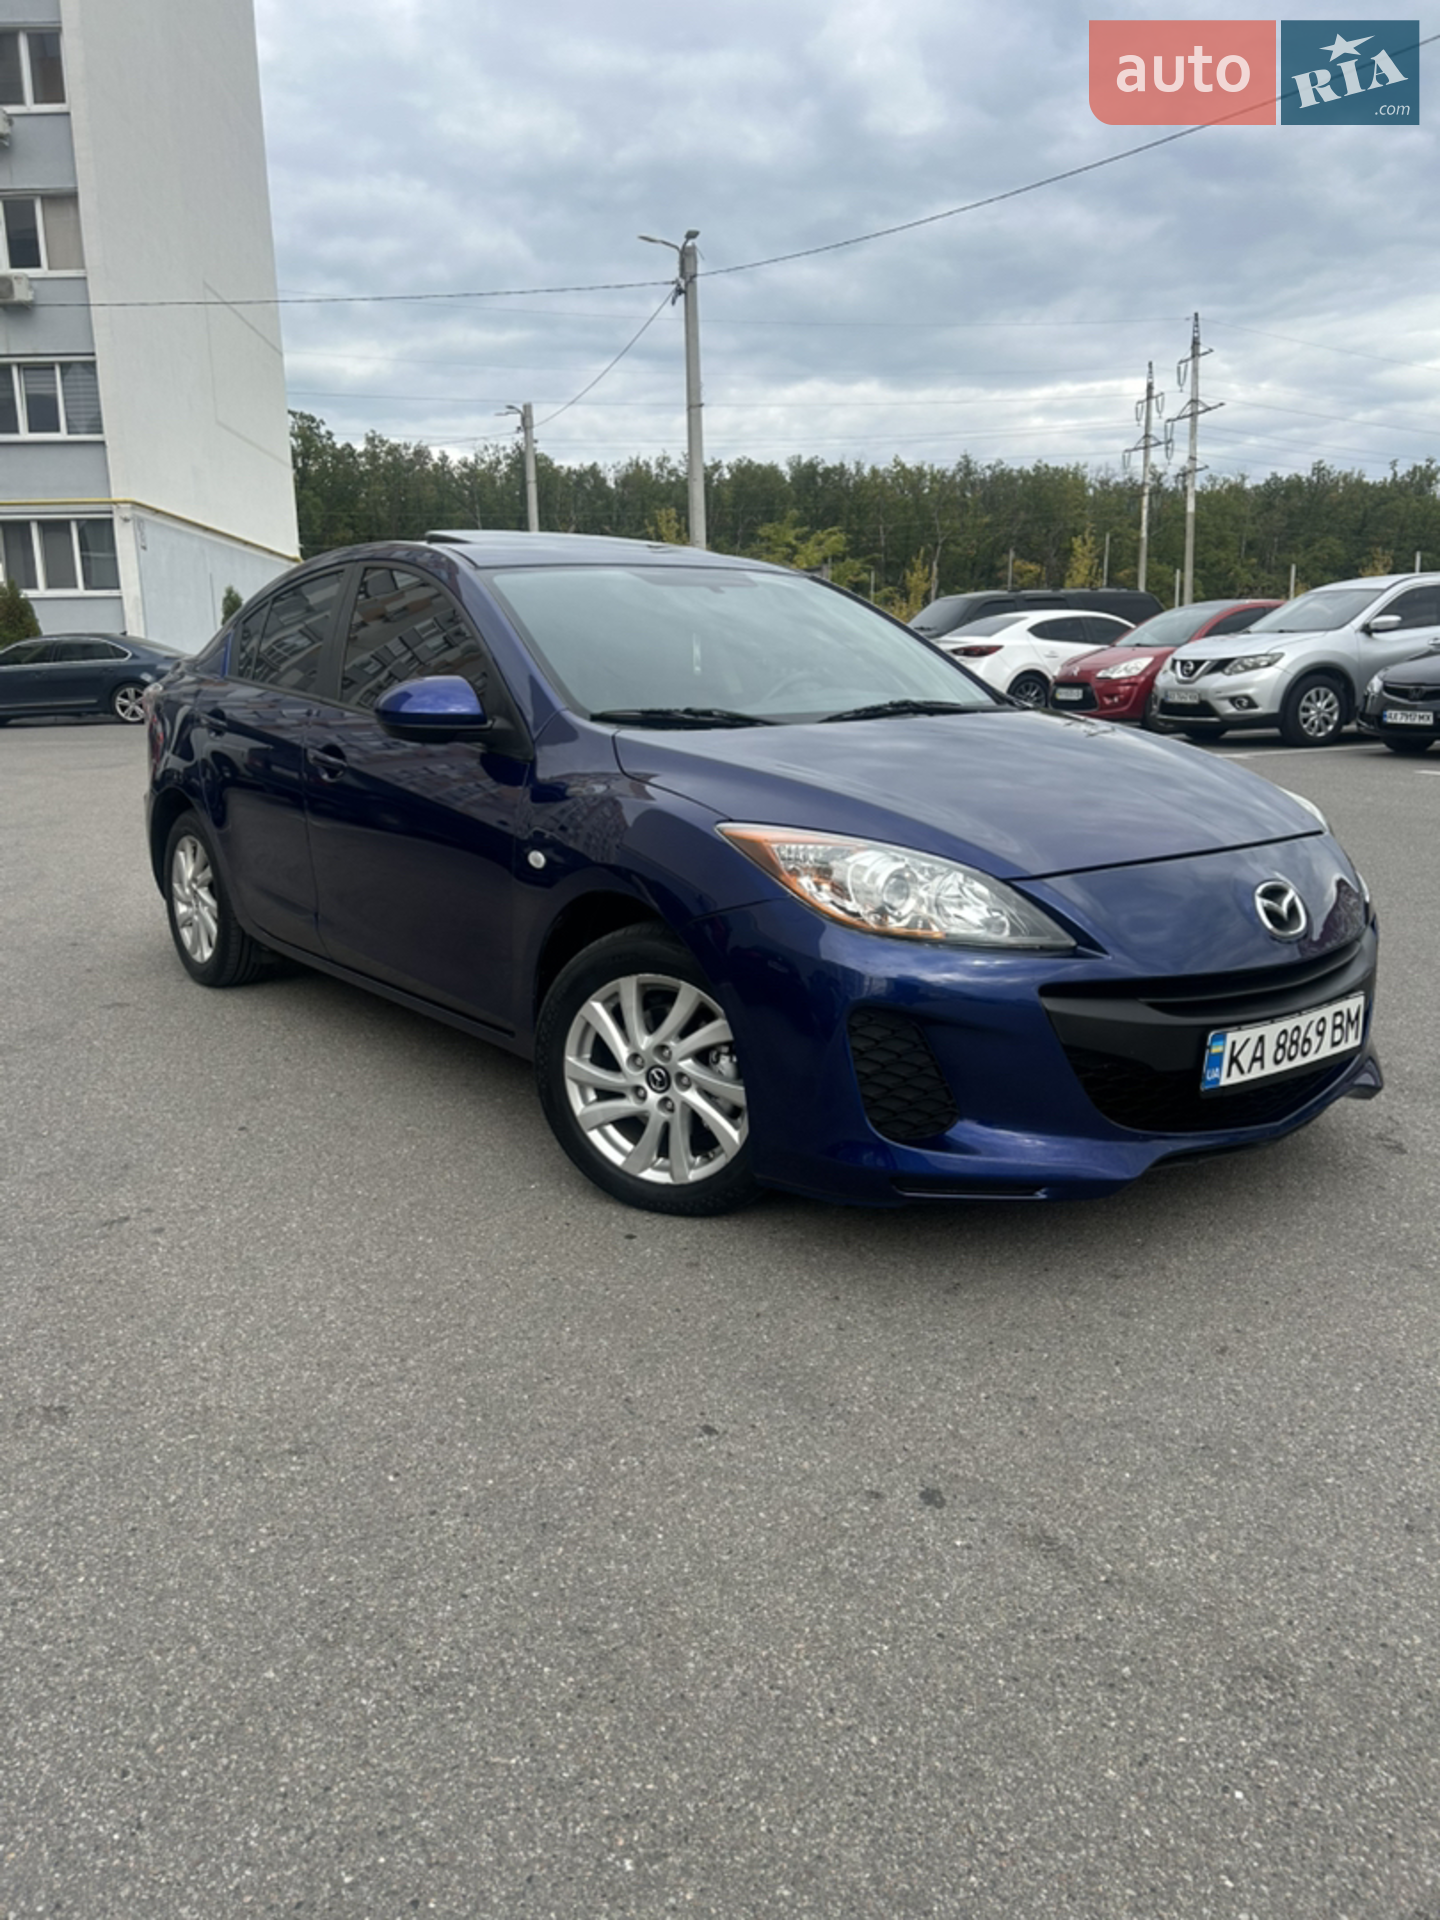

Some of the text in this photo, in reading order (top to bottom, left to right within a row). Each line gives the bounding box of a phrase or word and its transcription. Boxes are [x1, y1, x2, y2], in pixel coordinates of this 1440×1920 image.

[1226, 1004, 1362, 1079] KA 8869 BM
